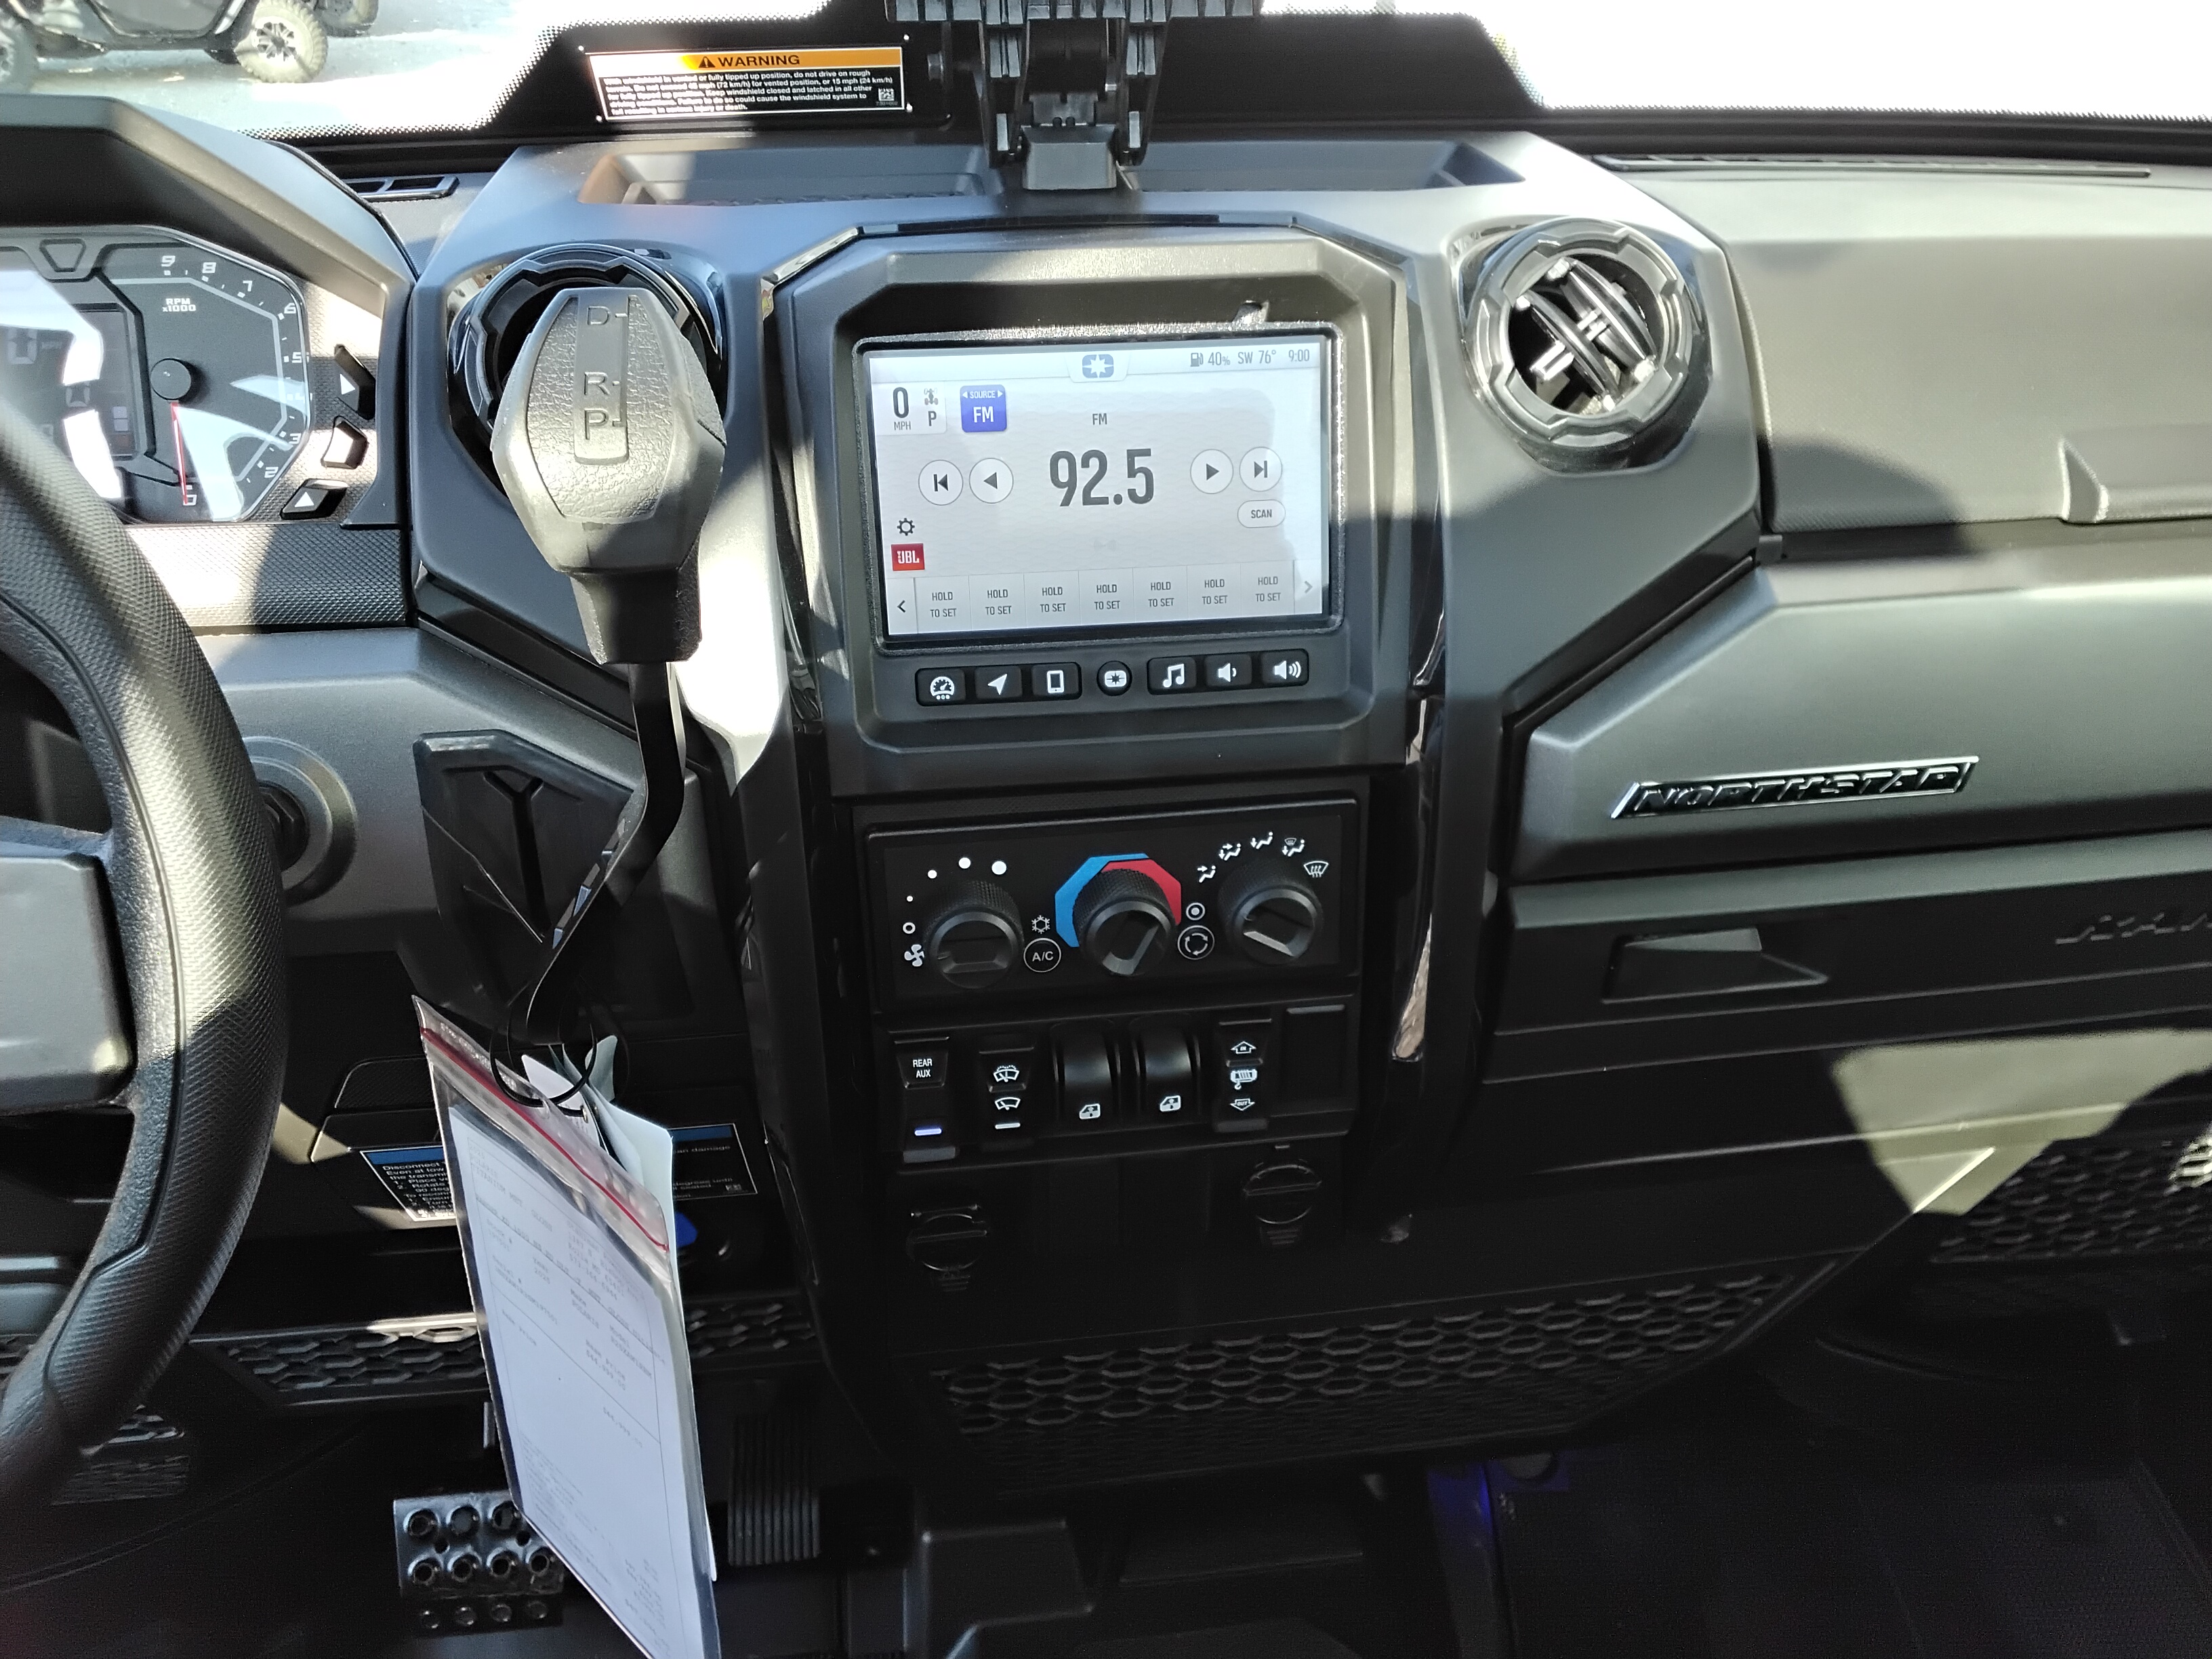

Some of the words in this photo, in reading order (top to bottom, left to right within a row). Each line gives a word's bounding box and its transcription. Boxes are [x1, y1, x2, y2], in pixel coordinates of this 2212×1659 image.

[718, 55, 800, 66] WARNING
[708, 74, 724, 82] fully
[725, 73, 749, 81] tipped
[761, 73, 792, 81] position,
[729, 80, 751, 88] km/h)
[790, 78, 821, 87] position,
[726, 87, 765, 96] windshield
[161, 255, 176, 267] 9
[202, 262, 217, 274] 8
[243, 280, 253, 292] 7
[165, 298, 191, 306] RPM
[162, 304, 197, 312] x1000
[283, 302, 297, 314] 6
[587, 306, 610, 326] D
[1208, 351, 1231, 366] 40%
[1237, 350, 1254, 365] SW
[1258, 349, 1277, 364] 76°
[1288, 348, 1310, 363] 9:00
[583, 371, 609, 396] R
[970, 390, 996, 399] SOURCE
[893, 386, 909, 419] 0
[928, 410, 937, 427] P
[972, 405, 995, 423] FM
[584, 408, 609, 441] P
[1092, 413, 1108, 426] FM
[893, 420, 912, 431] MPH
[289, 432, 302, 445] 3
[264, 466, 279, 478] 2
[1049, 448, 1155, 508] 92.5
[1250, 508, 1273, 519] SCAN
[897, 550, 920, 565] JBL
[1150, 581, 1172, 591] HOLD
[1204, 579, 1225, 588] HOLD
[1258, 576, 1279, 586] HOLD
[987, 589, 1009, 599] HOLD
[1042, 586, 1063, 596] HOLD
[1096, 584, 1118, 594] HOLD
[932, 592, 954, 601] HOLD
[1202, 596, 1212, 605] TO
[1214, 595, 1228, 605] SET
[1255, 593, 1265, 602] TO
[1267, 592, 1282, 602] SET
[1040, 604, 1050, 613] TO
[1052, 602, 1067, 613] SET
[1094, 601, 1104, 610] TO
[1107, 600, 1121, 610] SET
[1148, 598, 1158, 608] TO
[1160, 598, 1174, 607] SET
[930, 609, 941, 618] TO
[943, 608, 957, 617] SET
[985, 607, 996, 615] TO
[998, 605, 1012, 615] SET
[1633, 764, 1961, 812] NORTHSTAR
[1031, 951, 1054, 962] A/C
[912, 1058, 933, 1068] REAR
[916, 1069, 931, 1079] AUX
[382, 1162, 441, 1171] Disconnect
